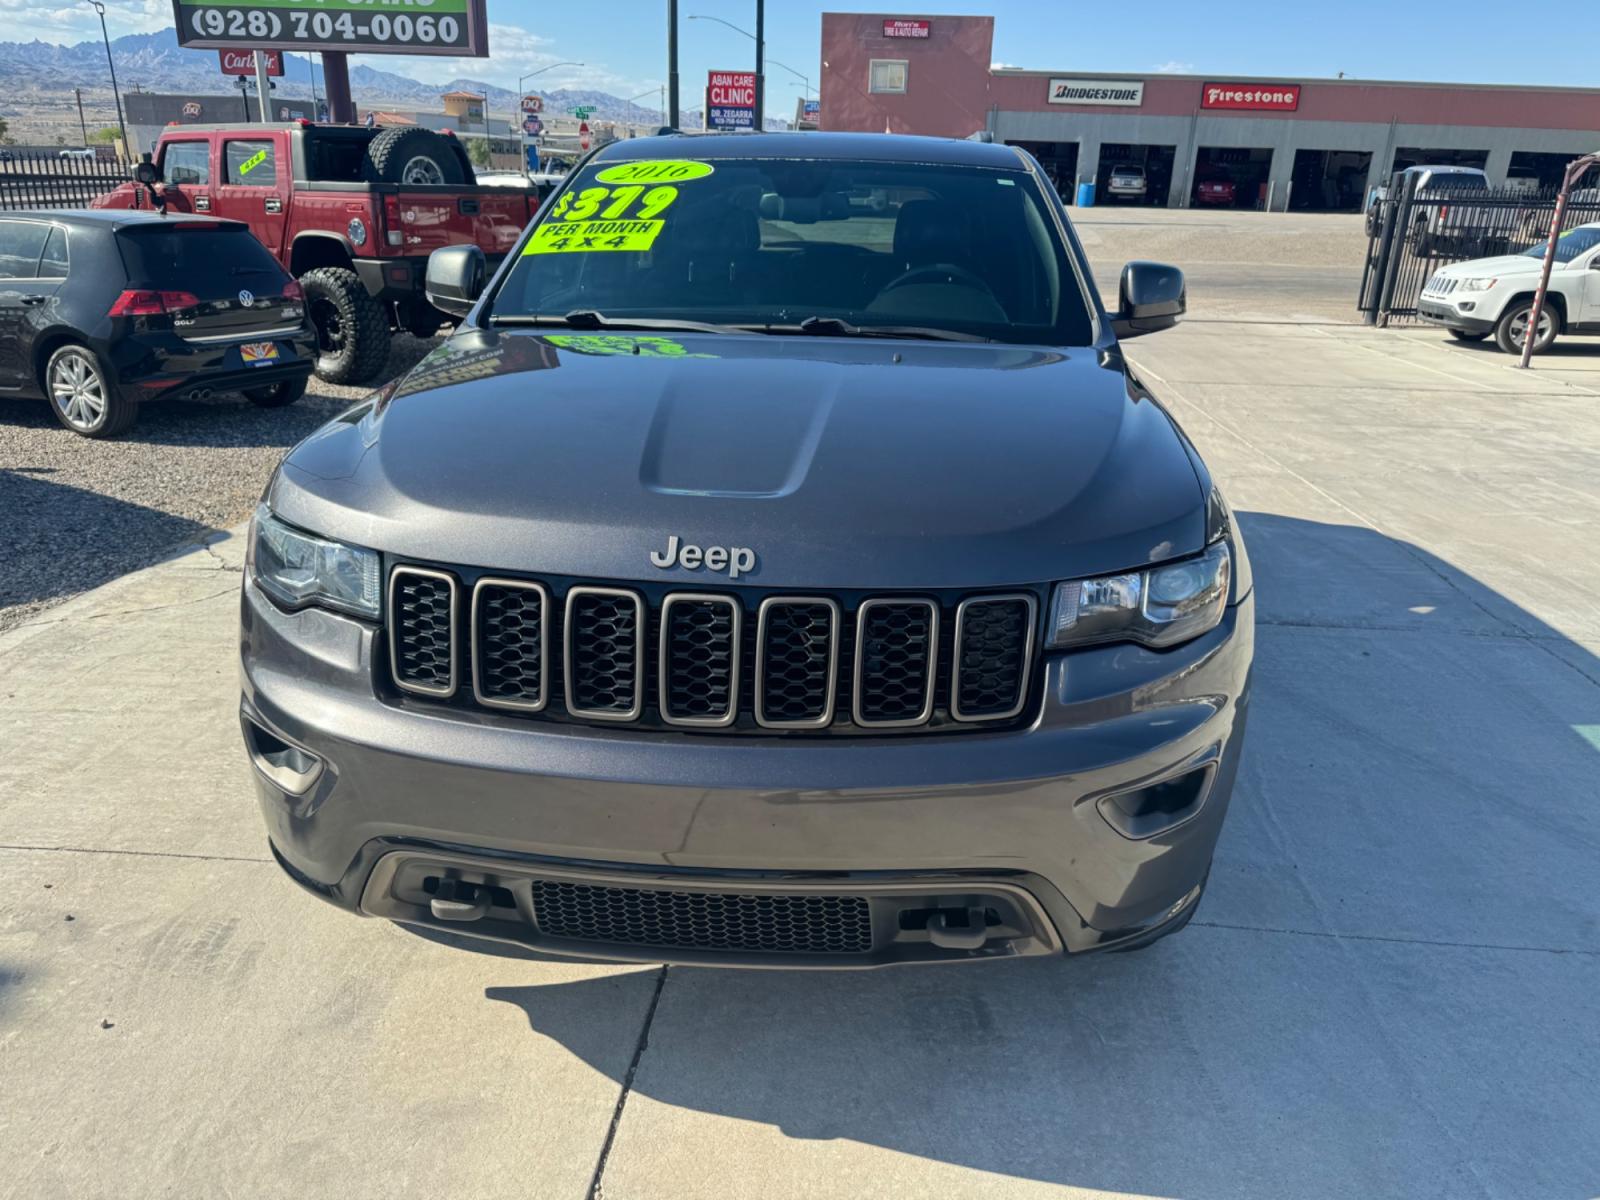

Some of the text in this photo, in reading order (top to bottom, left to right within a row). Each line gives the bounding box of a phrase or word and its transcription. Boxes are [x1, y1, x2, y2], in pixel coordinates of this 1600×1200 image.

[191, 9, 459, 43] (928) 704-0060
[733, 75, 753, 87] CARE
[711, 87, 753, 104] CLINIC
[1054, 85, 1138, 101] BRIDGESTONE
[1208, 88, 1294, 104] Firestone
[523, 99, 540, 110] DQ
[613, 165, 691, 180] 2016
[541, 219, 653, 237] PER MONTH
[650, 536, 756, 578] Jeep
